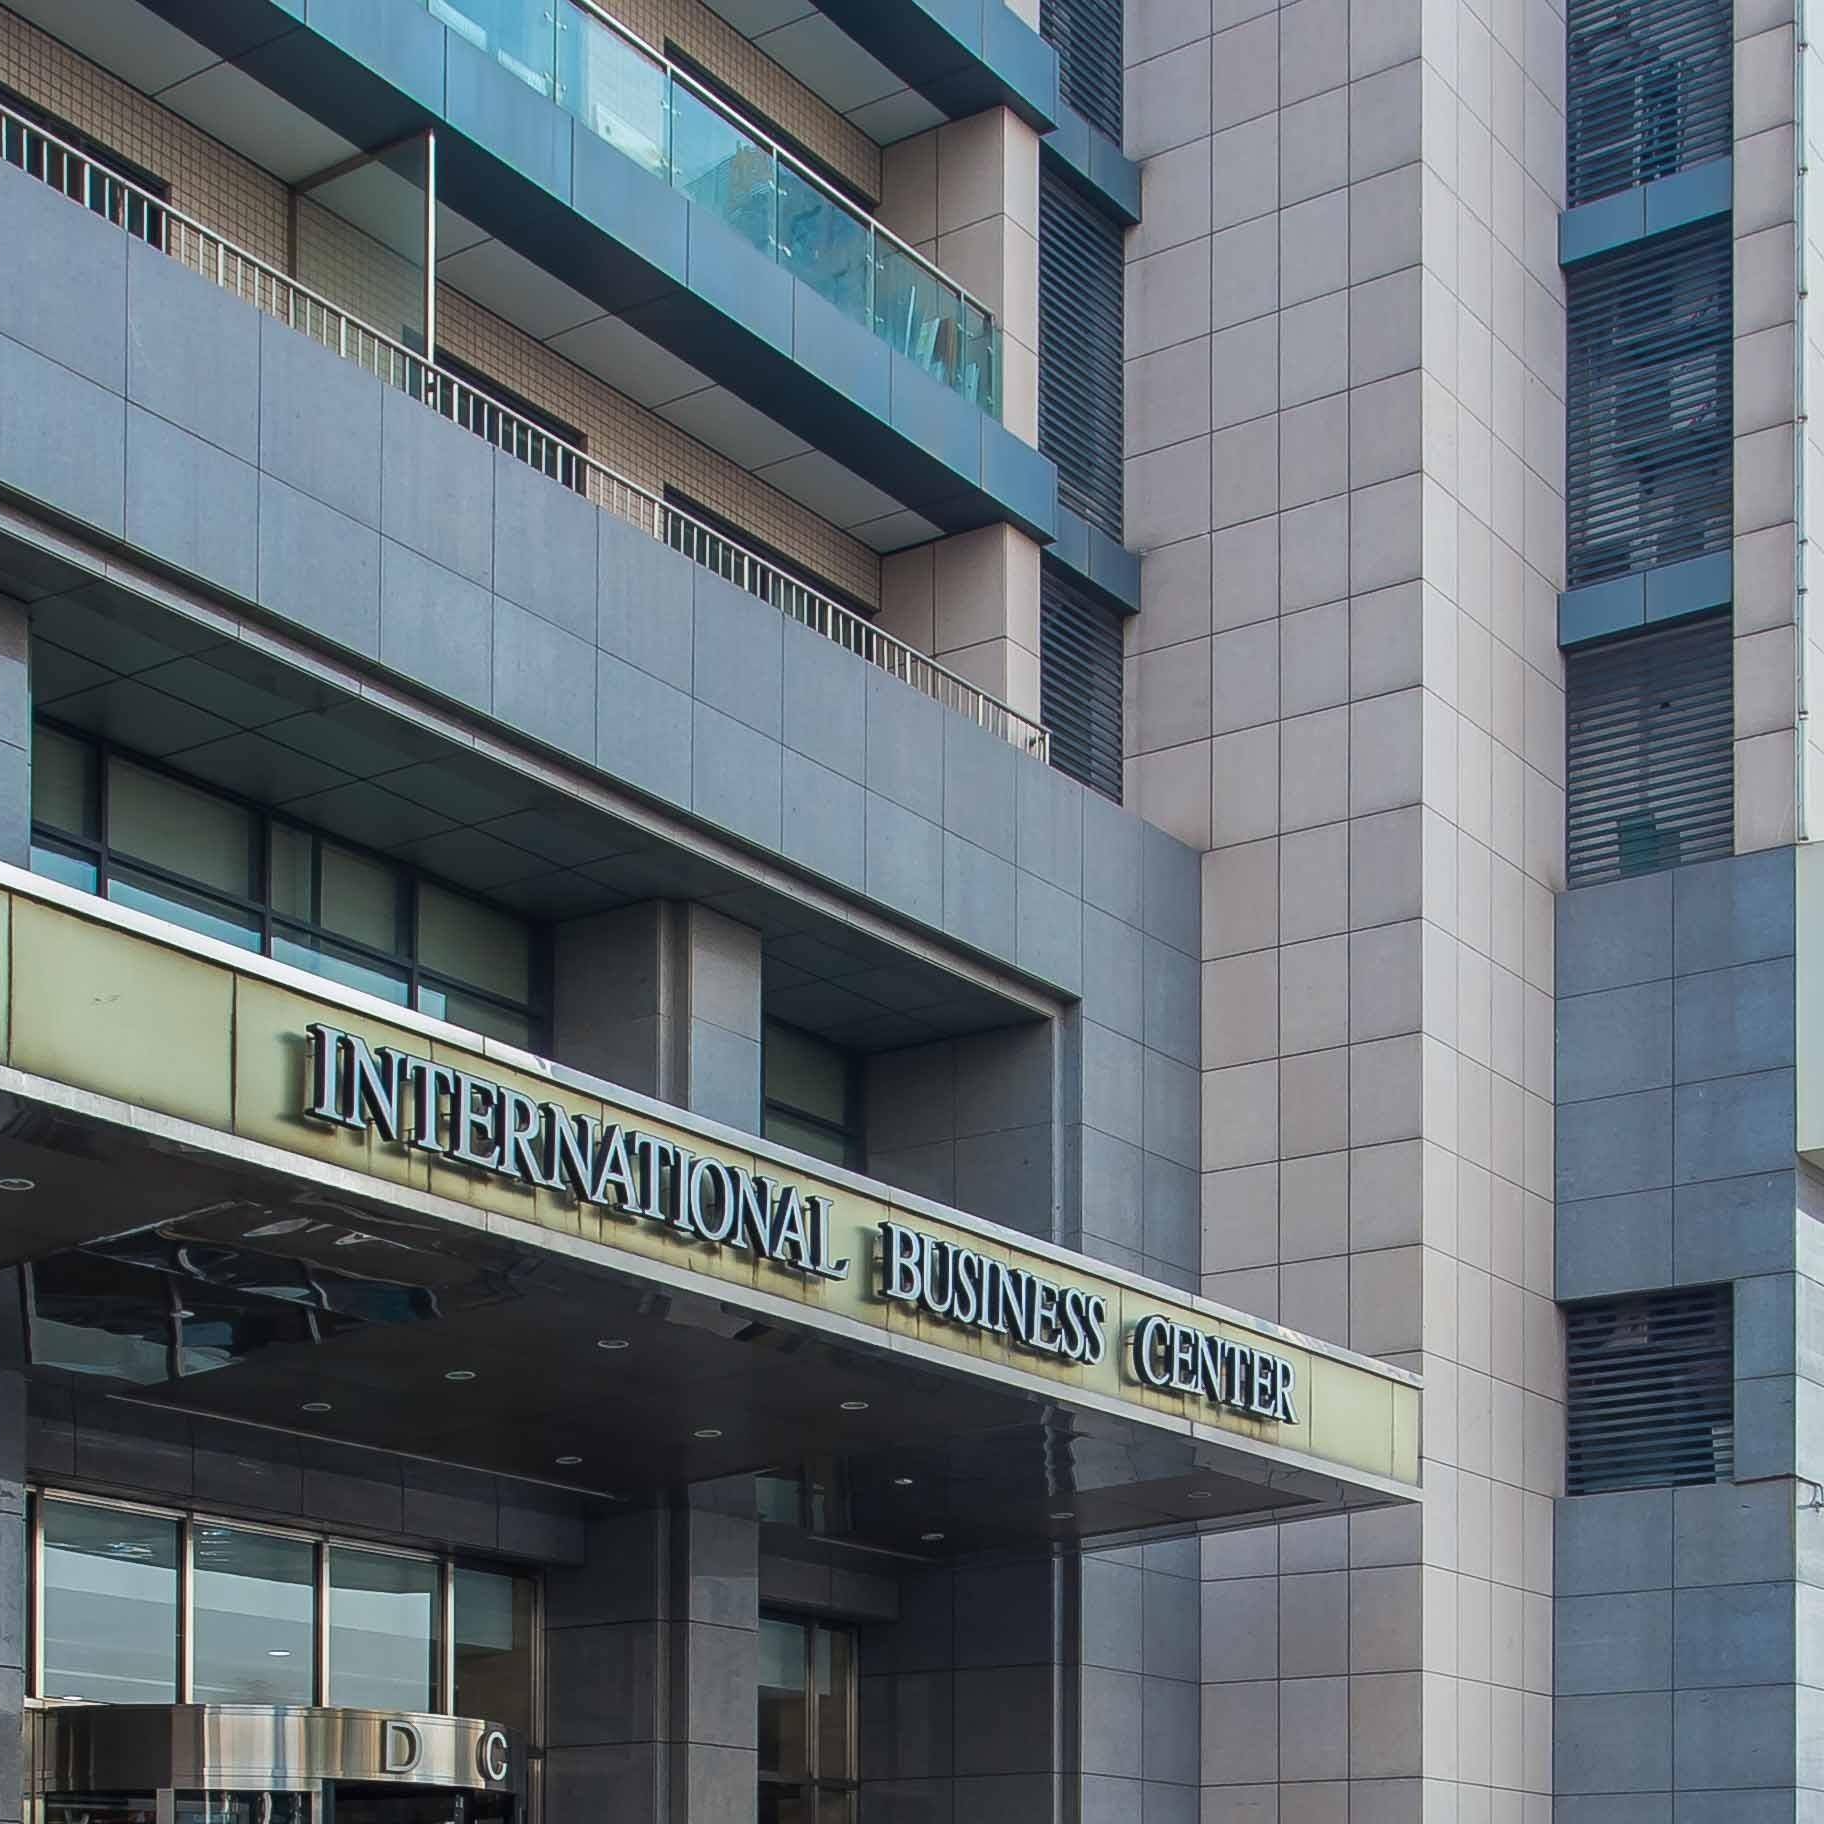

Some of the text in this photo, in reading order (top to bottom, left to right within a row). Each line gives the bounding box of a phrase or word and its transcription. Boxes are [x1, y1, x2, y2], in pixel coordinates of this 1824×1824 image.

[306, 1021, 1300, 1425] INTERNATIONAL BUSINESS CENTER
